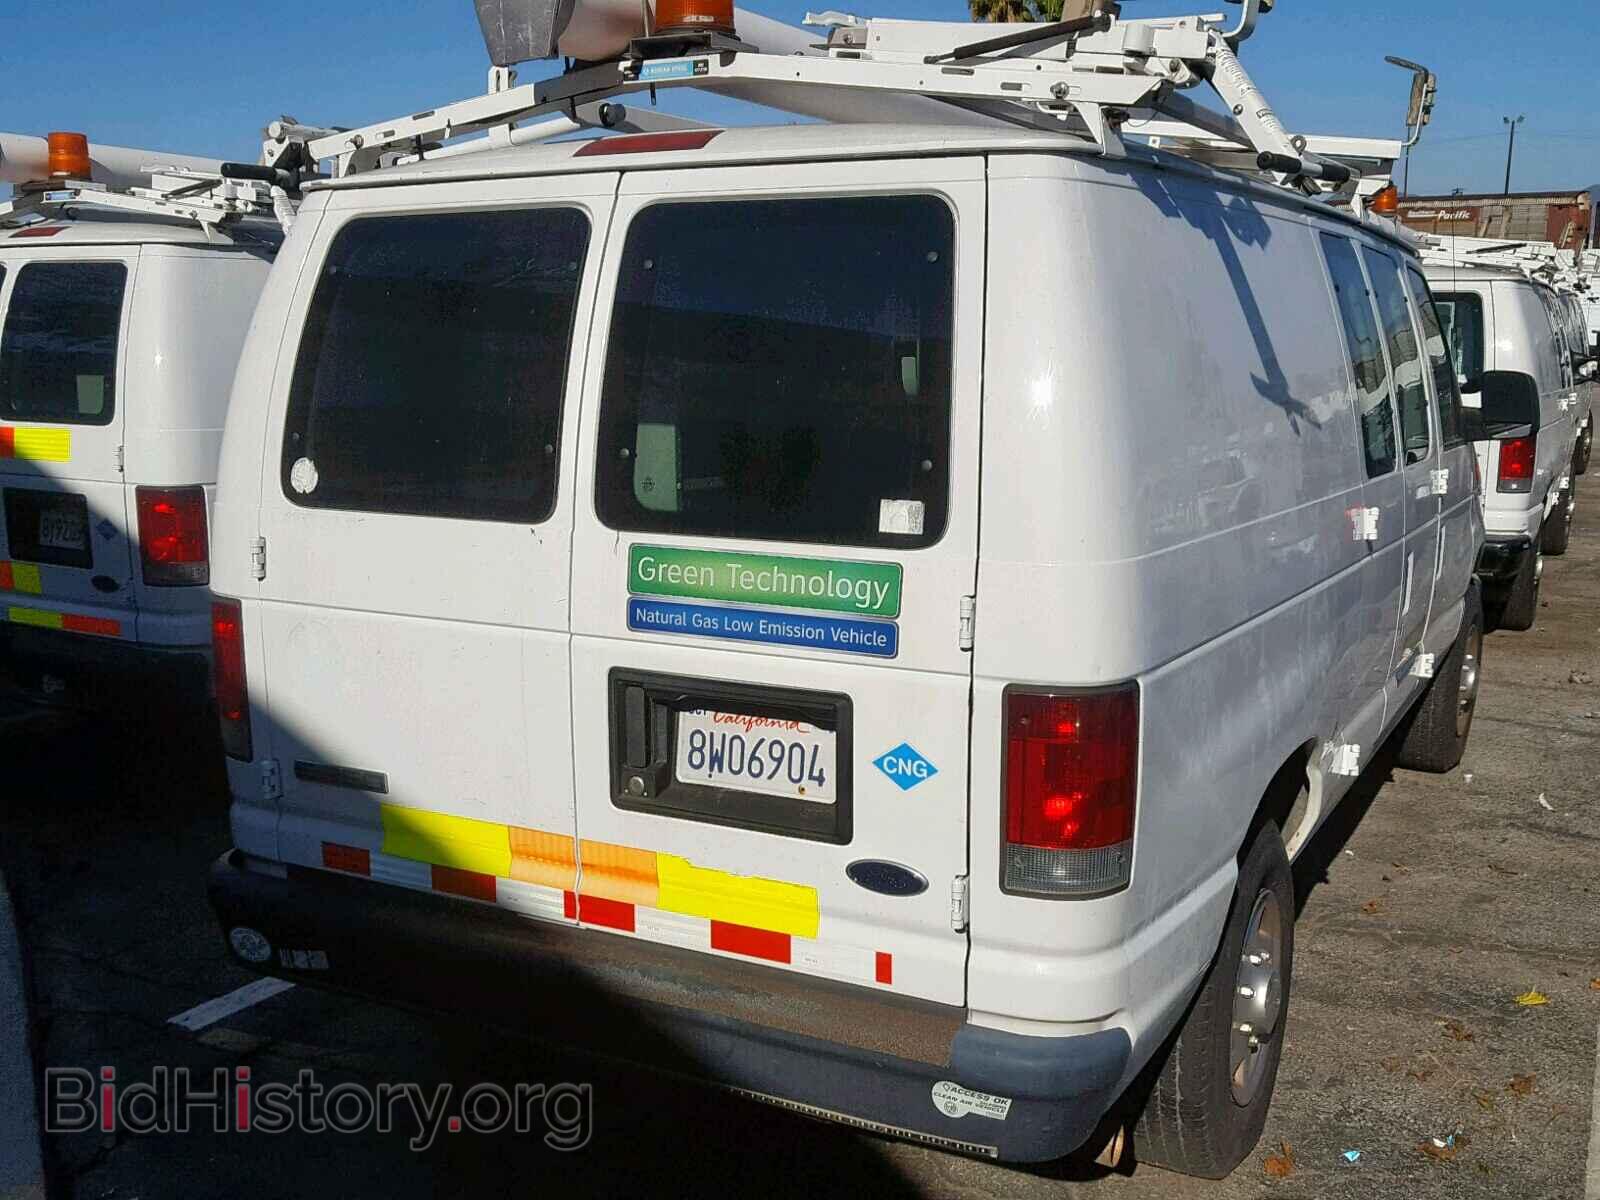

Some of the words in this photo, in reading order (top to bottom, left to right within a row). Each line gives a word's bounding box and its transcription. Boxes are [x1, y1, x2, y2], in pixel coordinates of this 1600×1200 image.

[638, 556, 714, 586] Green
[726, 563, 889, 609] Technology
[636, 607, 687, 627] Natural
[692, 612, 719, 630] Gas
[724, 616, 753, 633] Low
[759, 620, 824, 641] Emission
[830, 627, 888, 647] Vehicle
[688, 729, 826, 787] 8W06904
[882, 756, 928, 778] CNG
